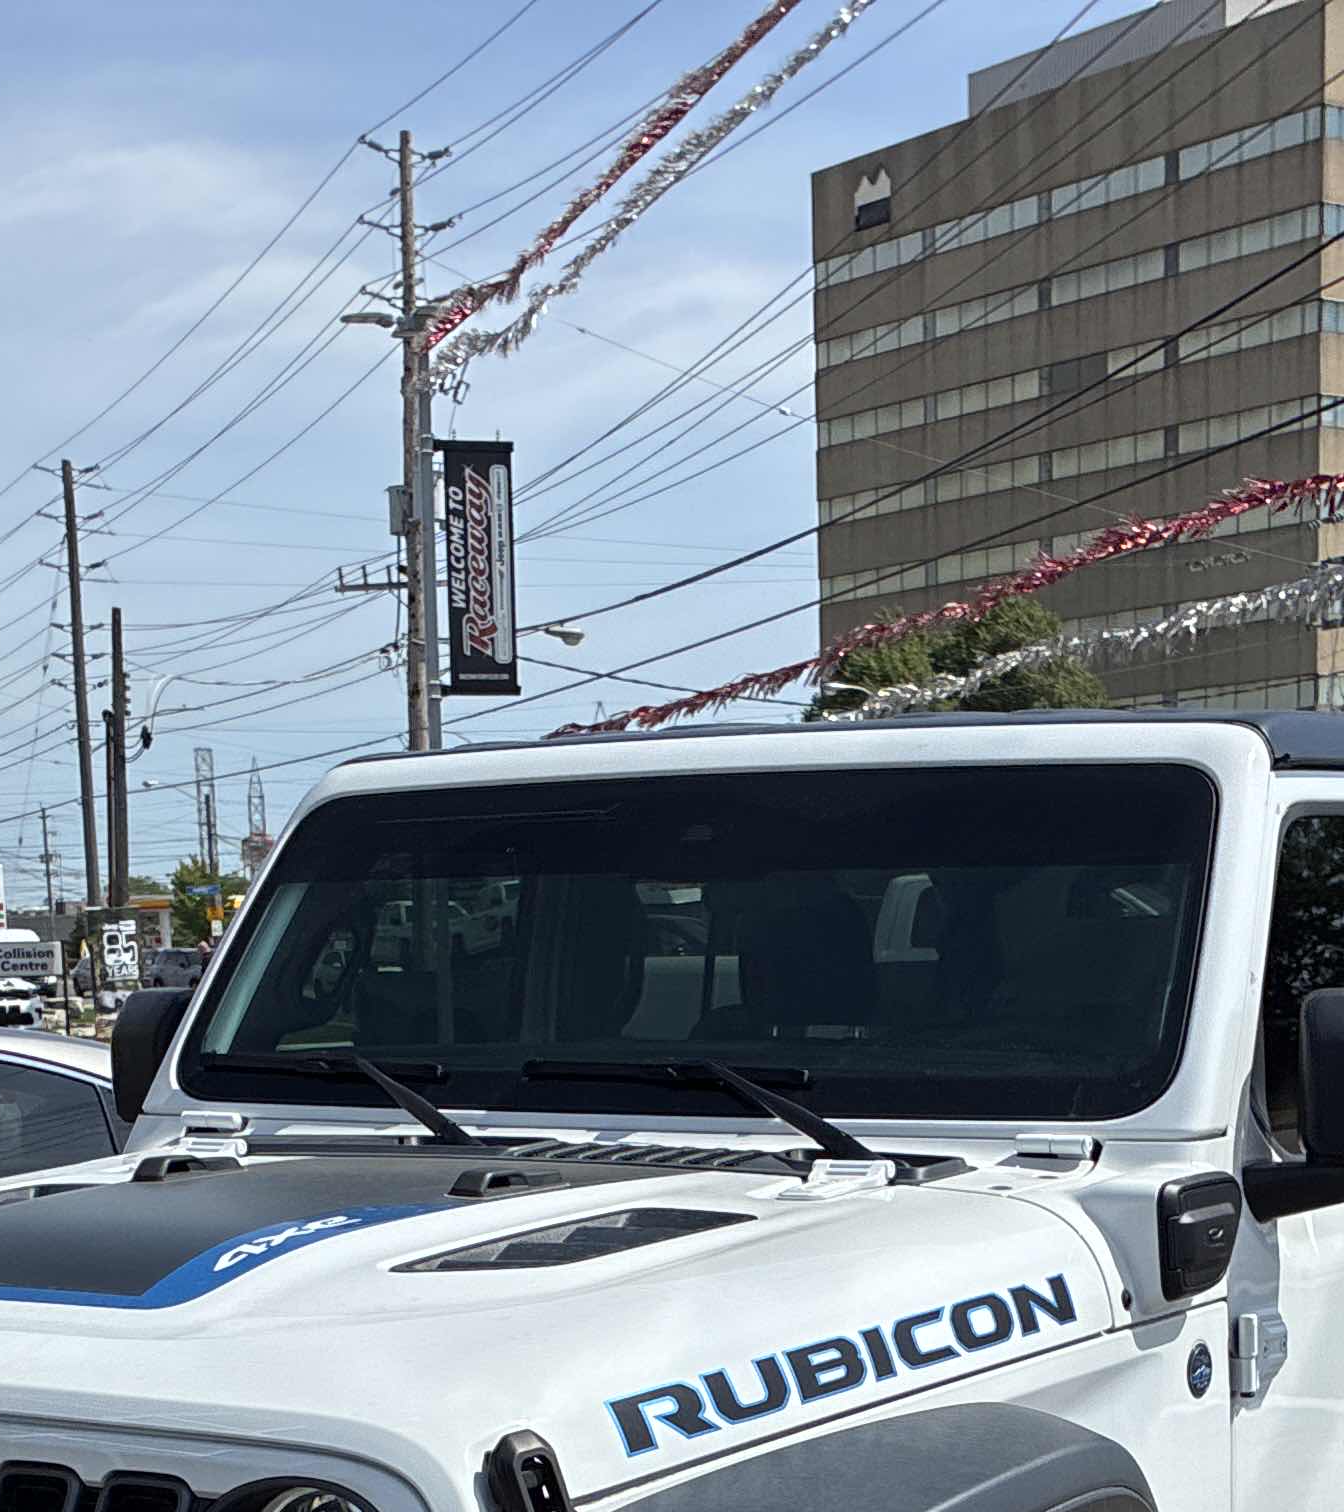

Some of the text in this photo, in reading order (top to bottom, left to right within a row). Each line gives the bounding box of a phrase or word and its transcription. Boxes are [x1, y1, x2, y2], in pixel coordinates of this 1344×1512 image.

[448, 486, 467, 608] WELCOME TO
[462, 464, 499, 658] Raceway
[0, 960, 49, 972] Centre
[212, 1214, 363, 1272] 4xe
[604, 1272, 1078, 1458] RUBICON
